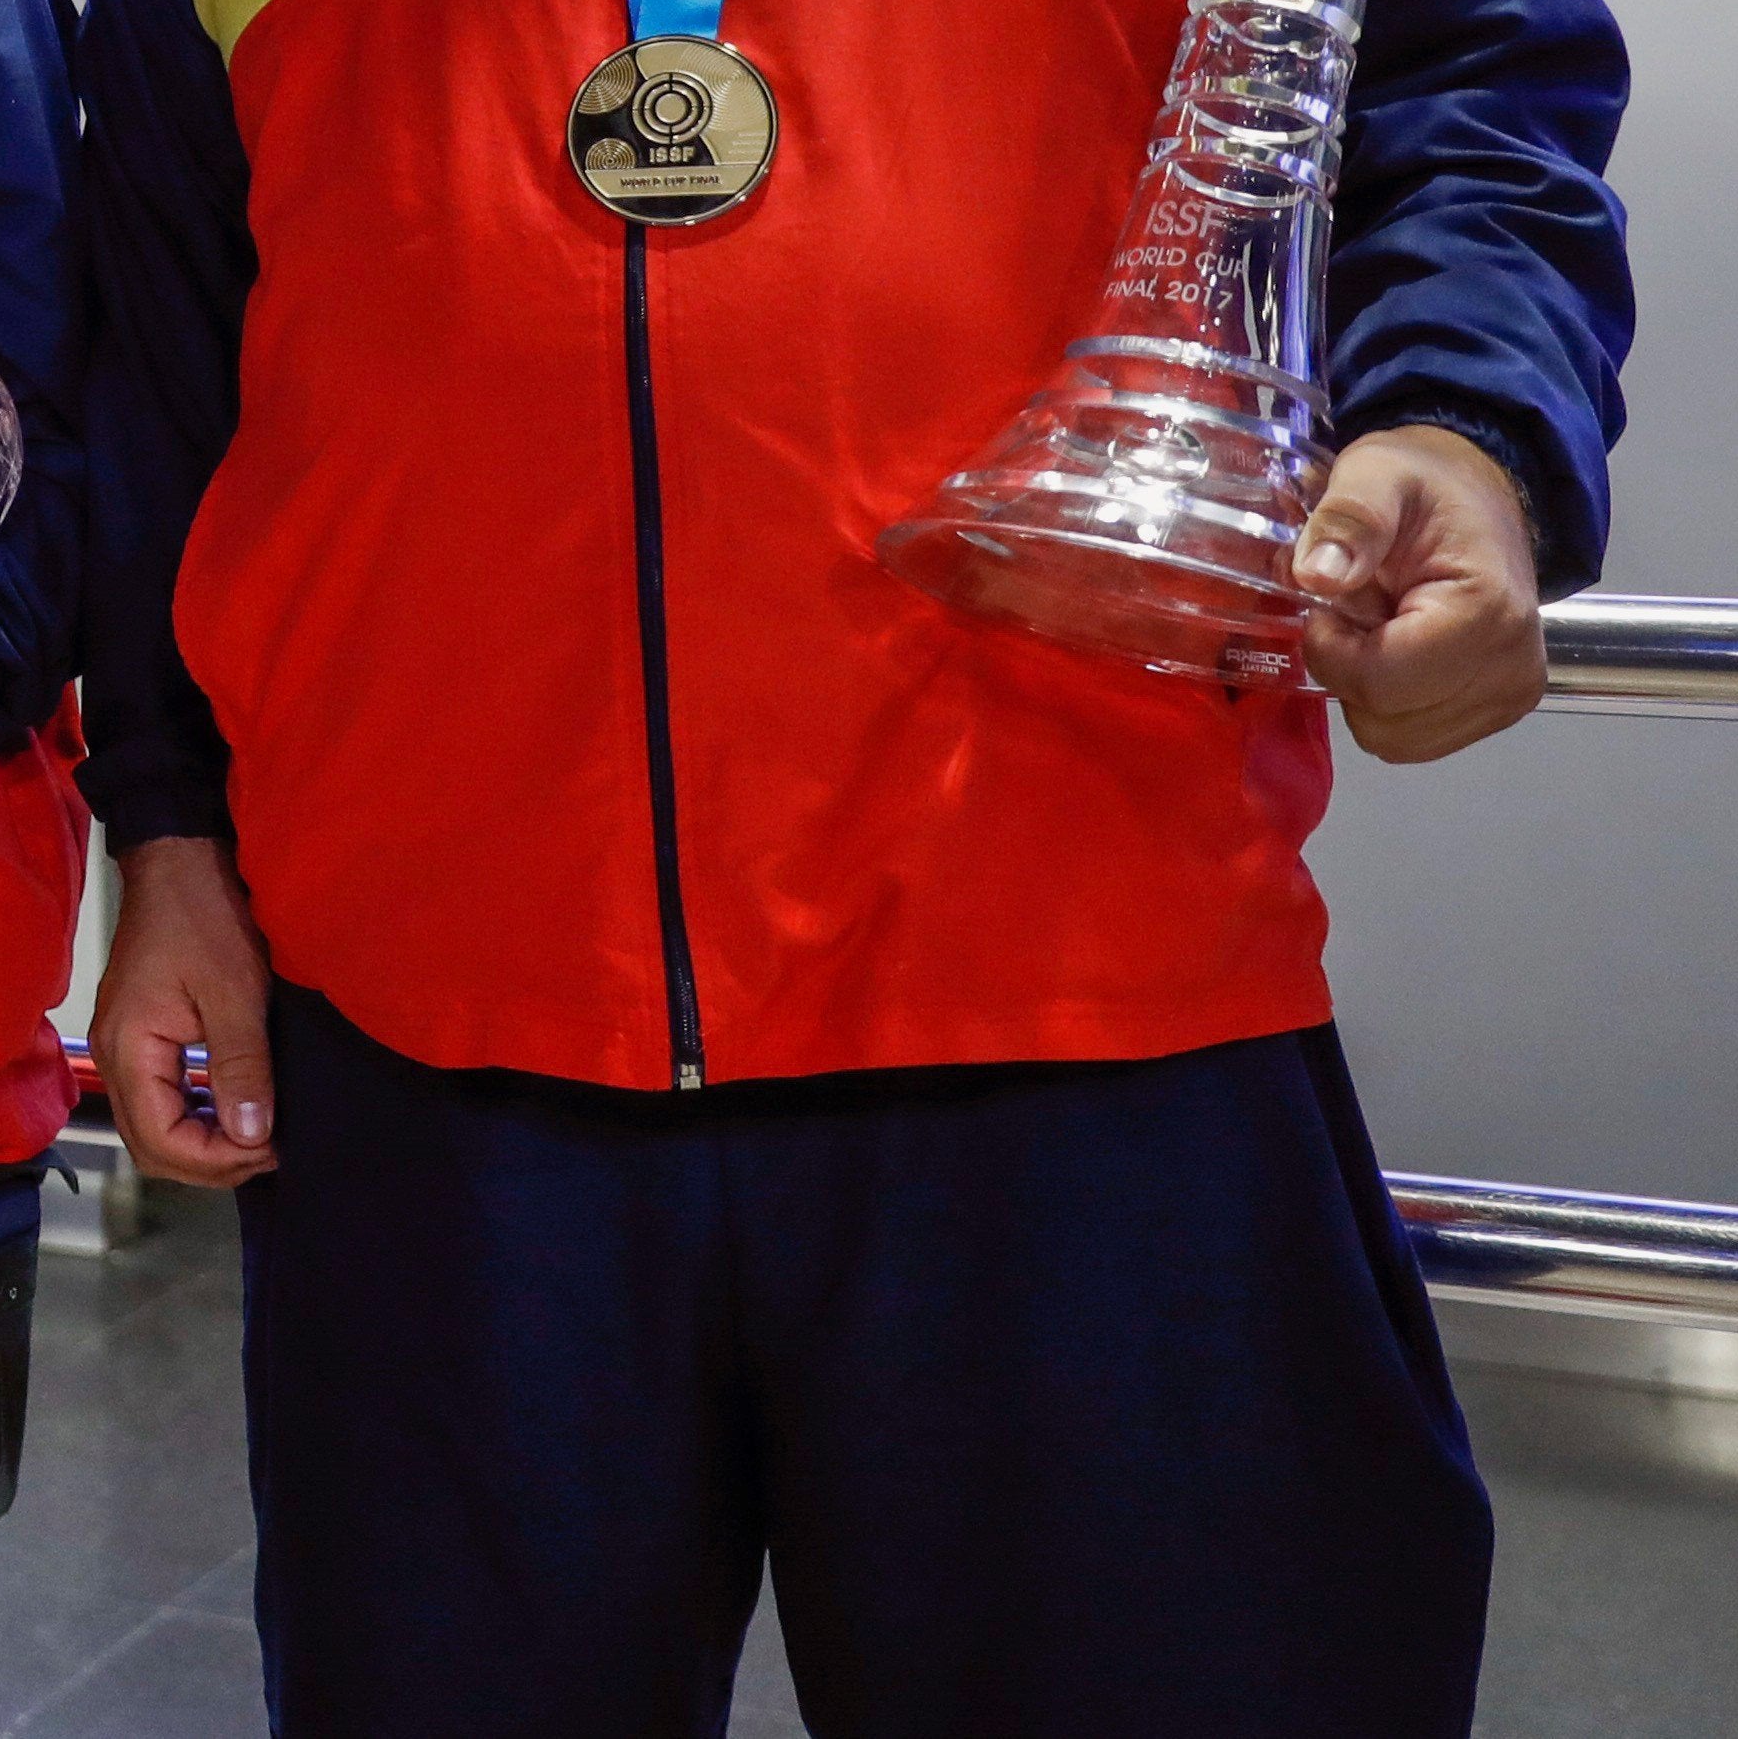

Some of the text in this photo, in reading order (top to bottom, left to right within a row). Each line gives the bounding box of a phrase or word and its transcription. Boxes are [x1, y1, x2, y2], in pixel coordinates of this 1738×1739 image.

[649, 146, 696, 162] ISSF
[1144, 200, 1227, 238] ISSF
[1114, 246, 1187, 270] WORLD
[1104, 278, 1234, 310] FINAL 2017
